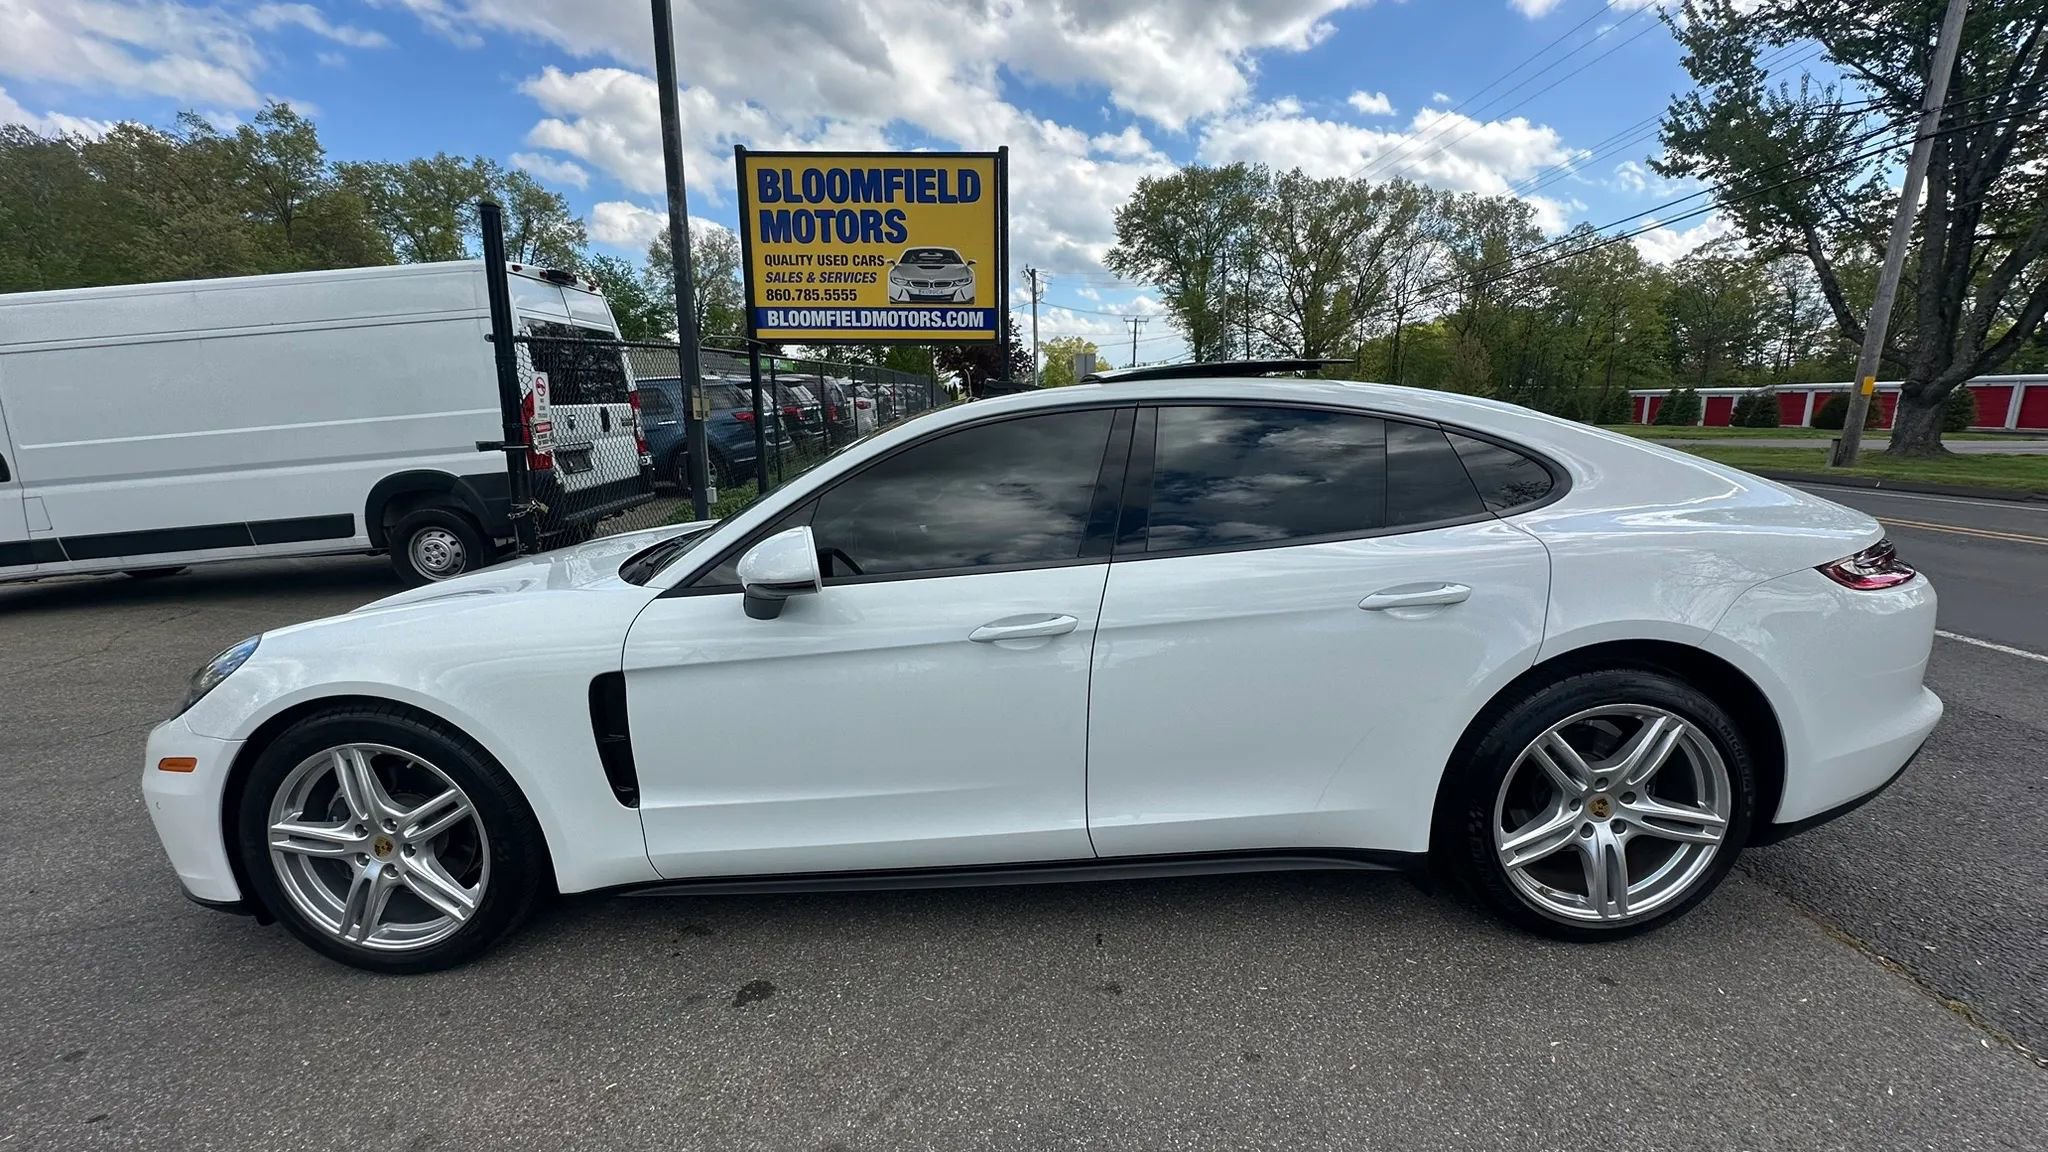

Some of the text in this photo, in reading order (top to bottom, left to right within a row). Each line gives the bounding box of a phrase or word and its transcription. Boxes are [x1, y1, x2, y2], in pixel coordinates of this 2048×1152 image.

[756, 168, 981, 204] BLOOMFIELD
[758, 208, 908, 244] MOTORS
[764, 254, 885, 267] QUALITY USED CARS
[765, 271, 877, 284] SALES & SERVICES
[766, 288, 857, 302] 860.785.5555
[767, 310, 984, 328] BLOOMFIELDMOTORS.COM
